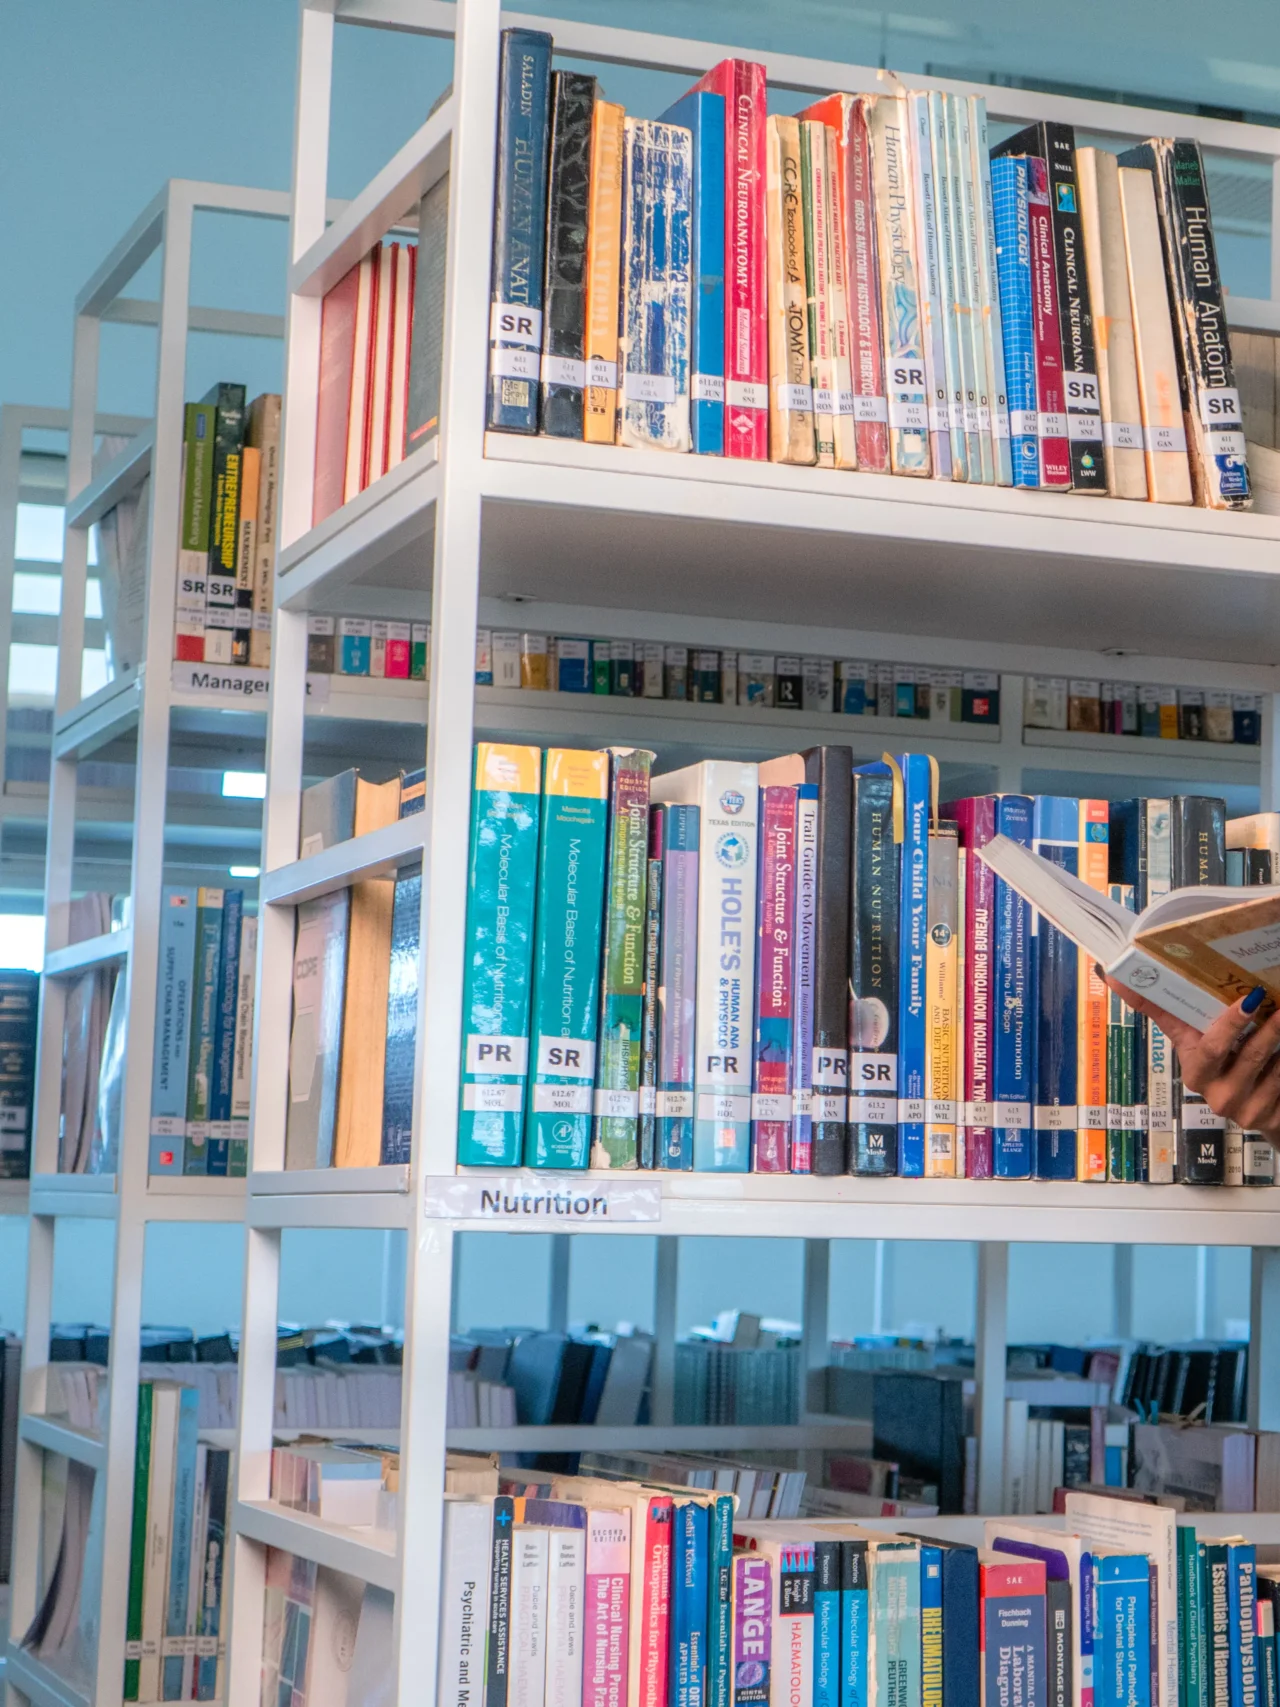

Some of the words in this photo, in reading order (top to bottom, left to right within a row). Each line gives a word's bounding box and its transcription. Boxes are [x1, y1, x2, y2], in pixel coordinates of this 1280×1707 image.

[521, 55, 534, 117] SALADIN
[885, 125, 900, 191] Human
[1054, 141, 1070, 150] SAE
[1055, 163, 1073, 172] SNELL
[1016, 166, 1029, 267] PHYSIOLOGY
[885, 195, 909, 284] Physiology
[1039, 216, 1050, 258] Clinical
[1185, 206, 1211, 287] Human
[1042, 261, 1053, 316] Anatomy
[501, 315, 532, 335] SR
[894, 369, 924, 385] SR
[1068, 382, 1096, 399] SR
[1208, 398, 1236, 414] SR
[221, 454, 239, 569] ENTREPRENEURSHIP
[183, 580, 206, 593] SR
[210, 583, 233, 596] SR
[627, 798, 646, 835] Joint
[803, 810, 815, 843] Trail
[912, 800, 925, 845] Your
[774, 825, 792, 859] Joint
[872, 813, 882, 876] HUMAN
[497, 834, 513, 903] Molecular
[566, 838, 581, 907] Molecular
[626, 839, 645, 901] Structure
[803, 846, 814, 891] Guide
[911, 848, 924, 899] Child
[774, 863, 791, 924] Structure
[802, 893, 812, 908] to
[496, 905, 509, 943] Basis
[564, 910, 578, 947] Basis
[626, 905, 641, 920] &
[720, 878, 742, 971] HOLE'S
[911, 906, 923, 949] Your
[495, 945, 508, 961] of
[624, 924, 640, 984] Function
[774, 928, 787, 943] &
[801, 912, 813, 987] Movement
[872, 886, 881, 988] NUTRITION
[564, 948, 575, 964] of
[492, 963, 507, 1028] Nutrition
[772, 947, 788, 1007] Function
[908, 954, 922, 1017] Family
[561, 966, 575, 1026] Nutrition
[942, 1008, 951, 1040] BASIC
[219, 1030, 234, 1094] Management
[236, 1023, 248, 1079] Management
[478, 1043, 512, 1062] PR
[548, 1048, 580, 1067] SR
[817, 1057, 846, 1075] PR
[862, 1064, 891, 1080] SR
[943, 1044, 951, 1100] NUTRITION
[866, 1148, 887, 1156] Mosby
[481, 1189, 608, 1216] Nutrition
[721, 1503, 730, 1551] Townsend
[500, 1539, 509, 1575] HEALTH
[685, 1548, 696, 1588] Kotwal
[852, 1554, 860, 1583] Pecorino
[499, 1577, 508, 1618] SERVICES
[597, 1577, 609, 1599] The
[611, 1577, 623, 1622] Clinical
[794, 1580, 802, 1602] Knight
[1115, 1597, 1124, 1612] for
[1189, 1600, 1195, 1608] of
[1212, 1563, 1229, 1633] Essentials
[460, 1581, 476, 1656] Psychiatric
[597, 1602, 609, 1620] Art
[743, 1559, 766, 1656] LANGE
[820, 1601, 830, 1650] Molecular
[850, 1600, 860, 1648] Molecular
[998, 1608, 1031, 1617] Fischbach
[1001, 1619, 1029, 1627] Dunning
[496, 1620, 506, 1675] ASSISTANCE
[596, 1624, 607, 1637] of
[608, 1625, 622, 1670] Nursing
[1115, 1614, 1124, 1649] Dental
[1166, 1620, 1175, 1654] Mental
[1213, 1635, 1228, 1648] of
[459, 1661, 470, 1685] and
[593, 1639, 608, 1684] Nursing
[818, 1652, 830, 1688] Biology
[848, 1651, 859, 1687] Biology
[1115, 1651, 1124, 1698] Students
[1166, 1655, 1176, 1690] Health
[1189, 1642, 1197, 1685] Psychiatry
[819, 1689, 829, 1701] of
[850, 1689, 859, 1701] of
